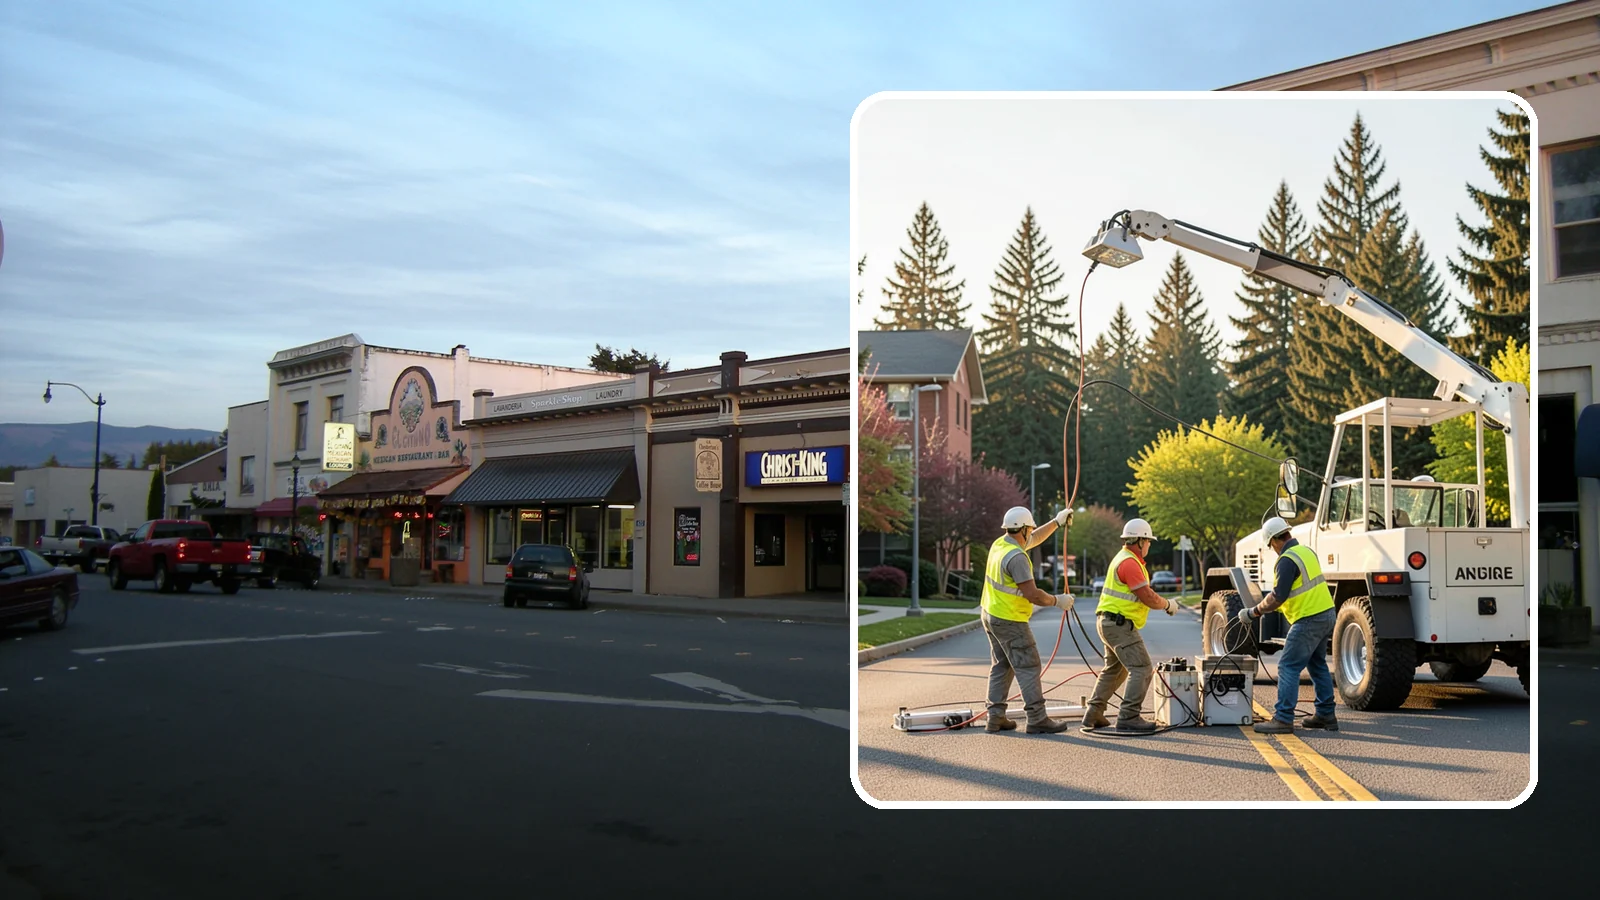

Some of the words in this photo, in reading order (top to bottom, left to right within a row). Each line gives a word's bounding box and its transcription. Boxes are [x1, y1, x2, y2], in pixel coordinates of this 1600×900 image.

[596, 389, 623, 399] LAUNDRY
[493, 402, 522, 412] LAVANDERIA
[562, 395, 582, 407] Shop
[397, 451, 433, 462] RESTAURANT
[438, 450, 450, 459] BAR
[761, 452, 797, 478] CHRIST
[799, 450, 827, 476] KING
